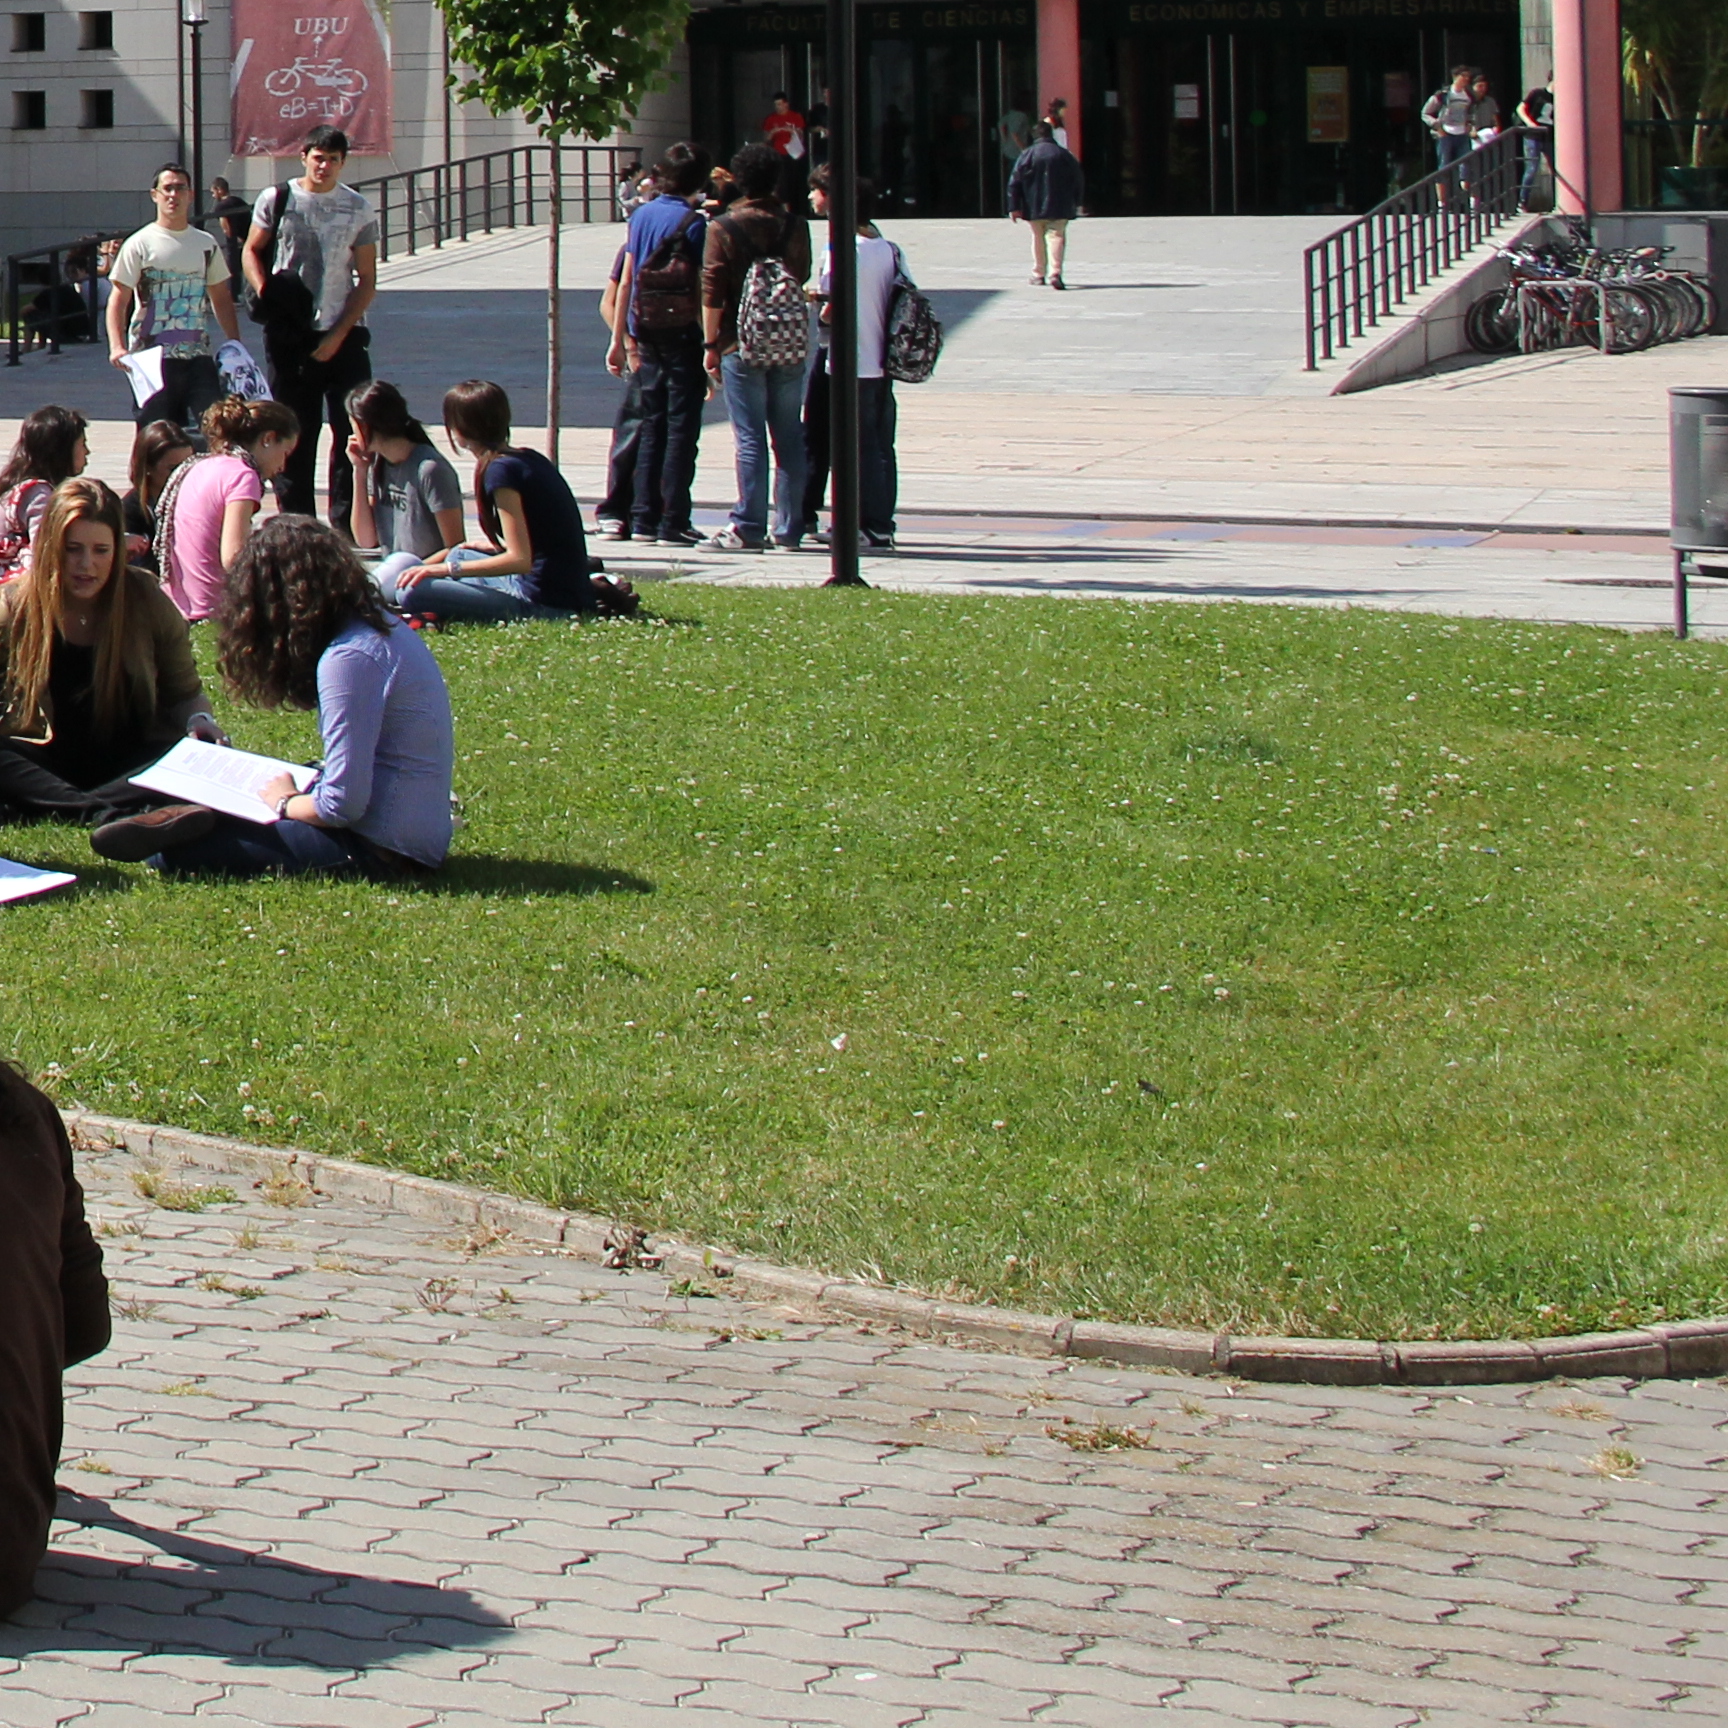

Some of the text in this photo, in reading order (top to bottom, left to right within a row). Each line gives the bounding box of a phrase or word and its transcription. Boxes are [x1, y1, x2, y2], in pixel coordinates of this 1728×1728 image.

[294, 16, 349, 36] UBU
[746, 13, 825, 32] FACULT
[872, 11, 901, 29] DE
[923, 8, 1028, 28] CIENCIAS
[1296, 0, 1309, 17] Y
[280, 96, 355, 120] eB=I+D
